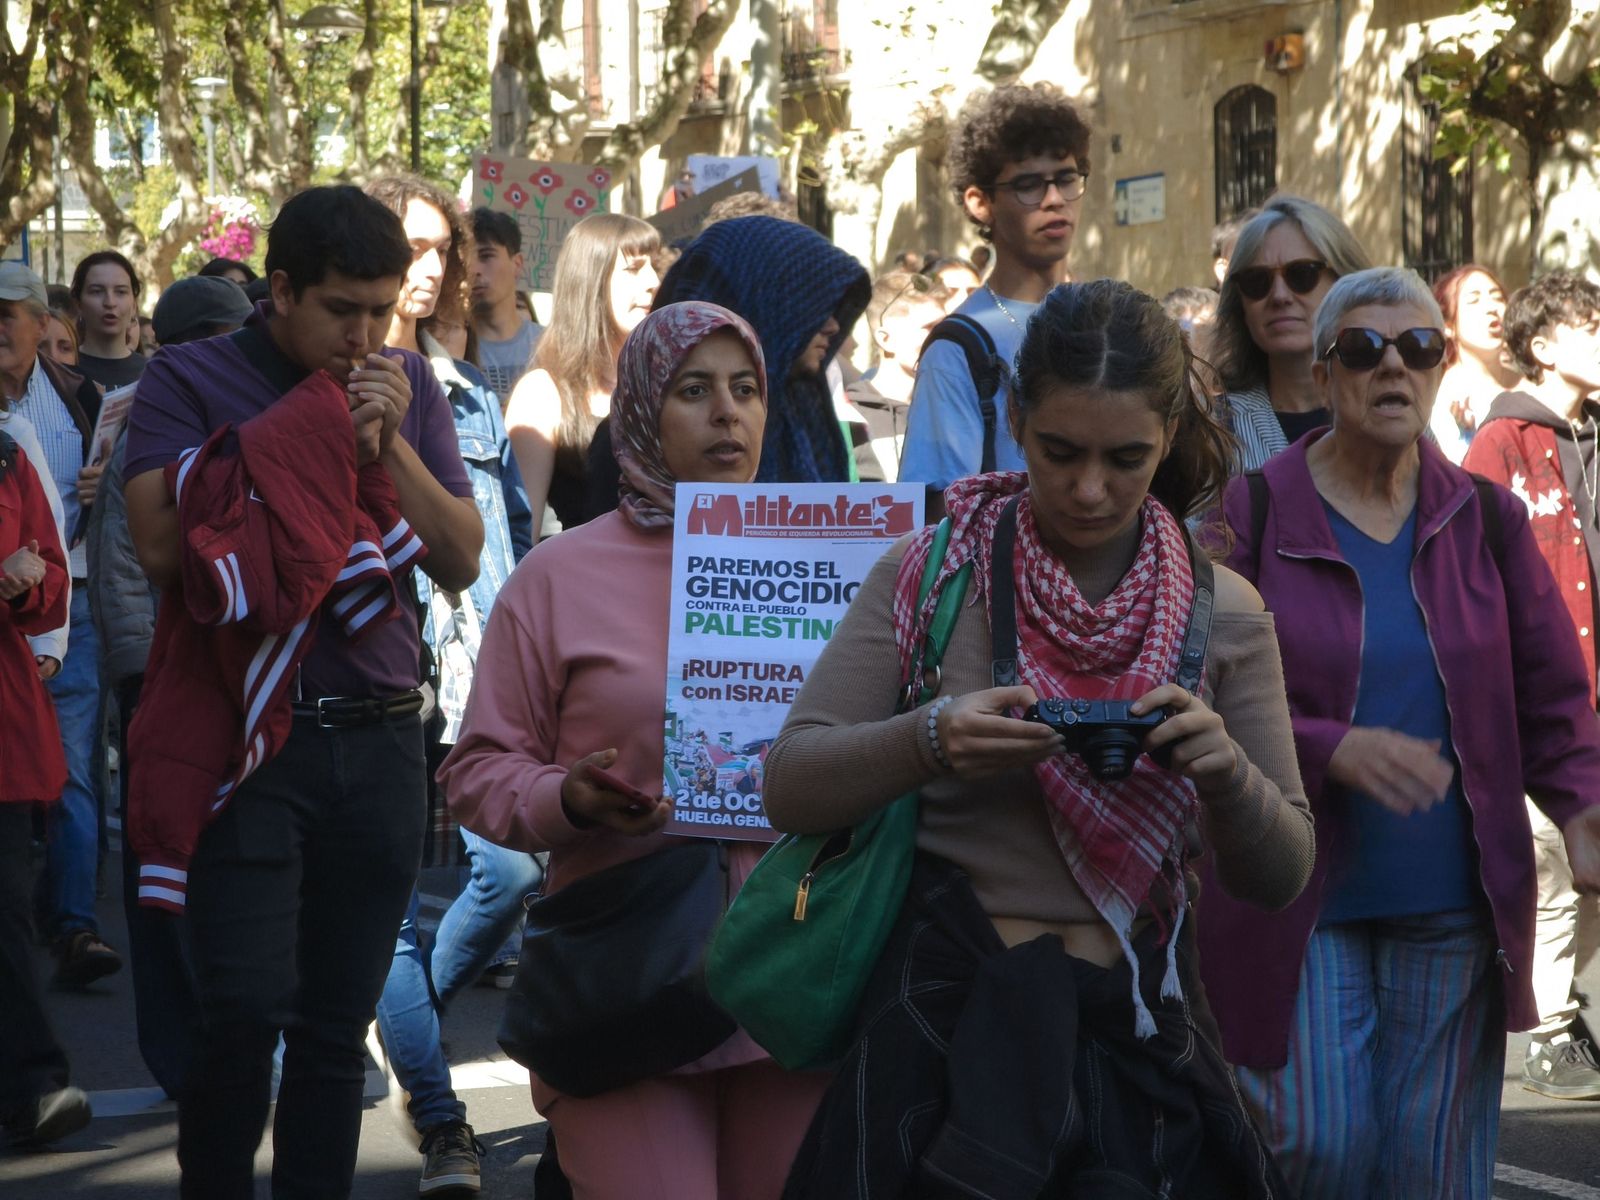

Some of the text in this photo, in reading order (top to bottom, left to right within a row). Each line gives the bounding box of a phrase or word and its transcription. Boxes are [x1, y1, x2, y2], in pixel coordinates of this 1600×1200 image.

[687, 494, 873, 537] Militante
[789, 530, 820, 538] IZQUIERDA
[687, 556, 841, 579] PAREMOS EL
[686, 600, 807, 616] CONTRA EL PUEBLO
[685, 611, 841, 641] PALESTIN
[682, 659, 804, 682] ¡RUPTURA
[682, 684, 799, 704] con ISRAE
[676, 789, 761, 812] 2 de OC
[674, 810, 733, 825] HUELGA
